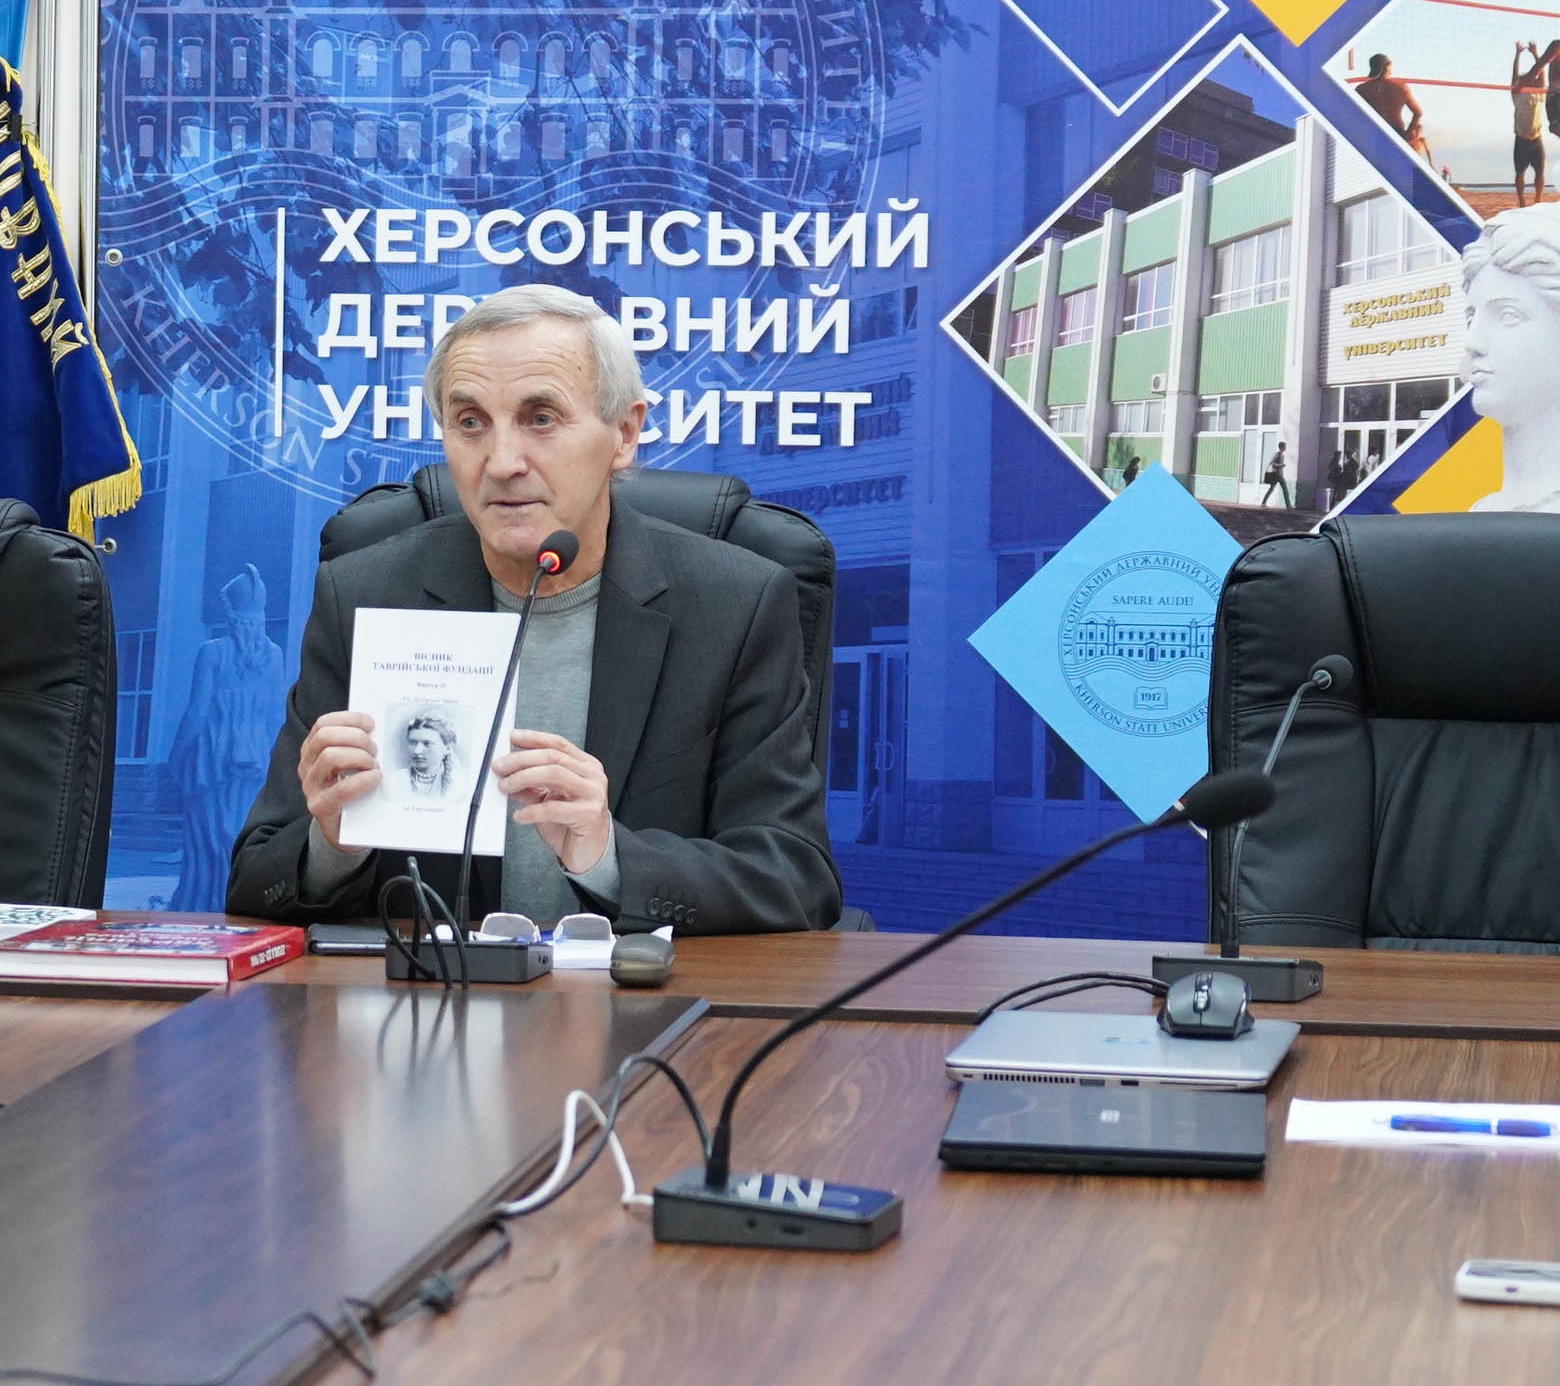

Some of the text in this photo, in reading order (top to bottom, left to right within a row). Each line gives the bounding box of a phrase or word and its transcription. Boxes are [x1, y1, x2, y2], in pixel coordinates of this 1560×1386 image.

[319, 198, 931, 269] ХЕРСОНСЬКИЙ
[317, 284, 850, 358] ДЕРВНИЙ
[1343, 333, 1448, 361] УНІВЕРСИТЕТ
[122, 283, 328, 471] KHERSON
[1063, 555, 1202, 656] ХЕРСОНСЬКИЙ ДЕРЖАВНИЙ
[1112, 595, 1154, 606] SAPERE
[1075, 684, 1121, 726] KHERSON
[1125, 720, 1160, 733] STATE
[1141, 692, 1162, 702] 1917
